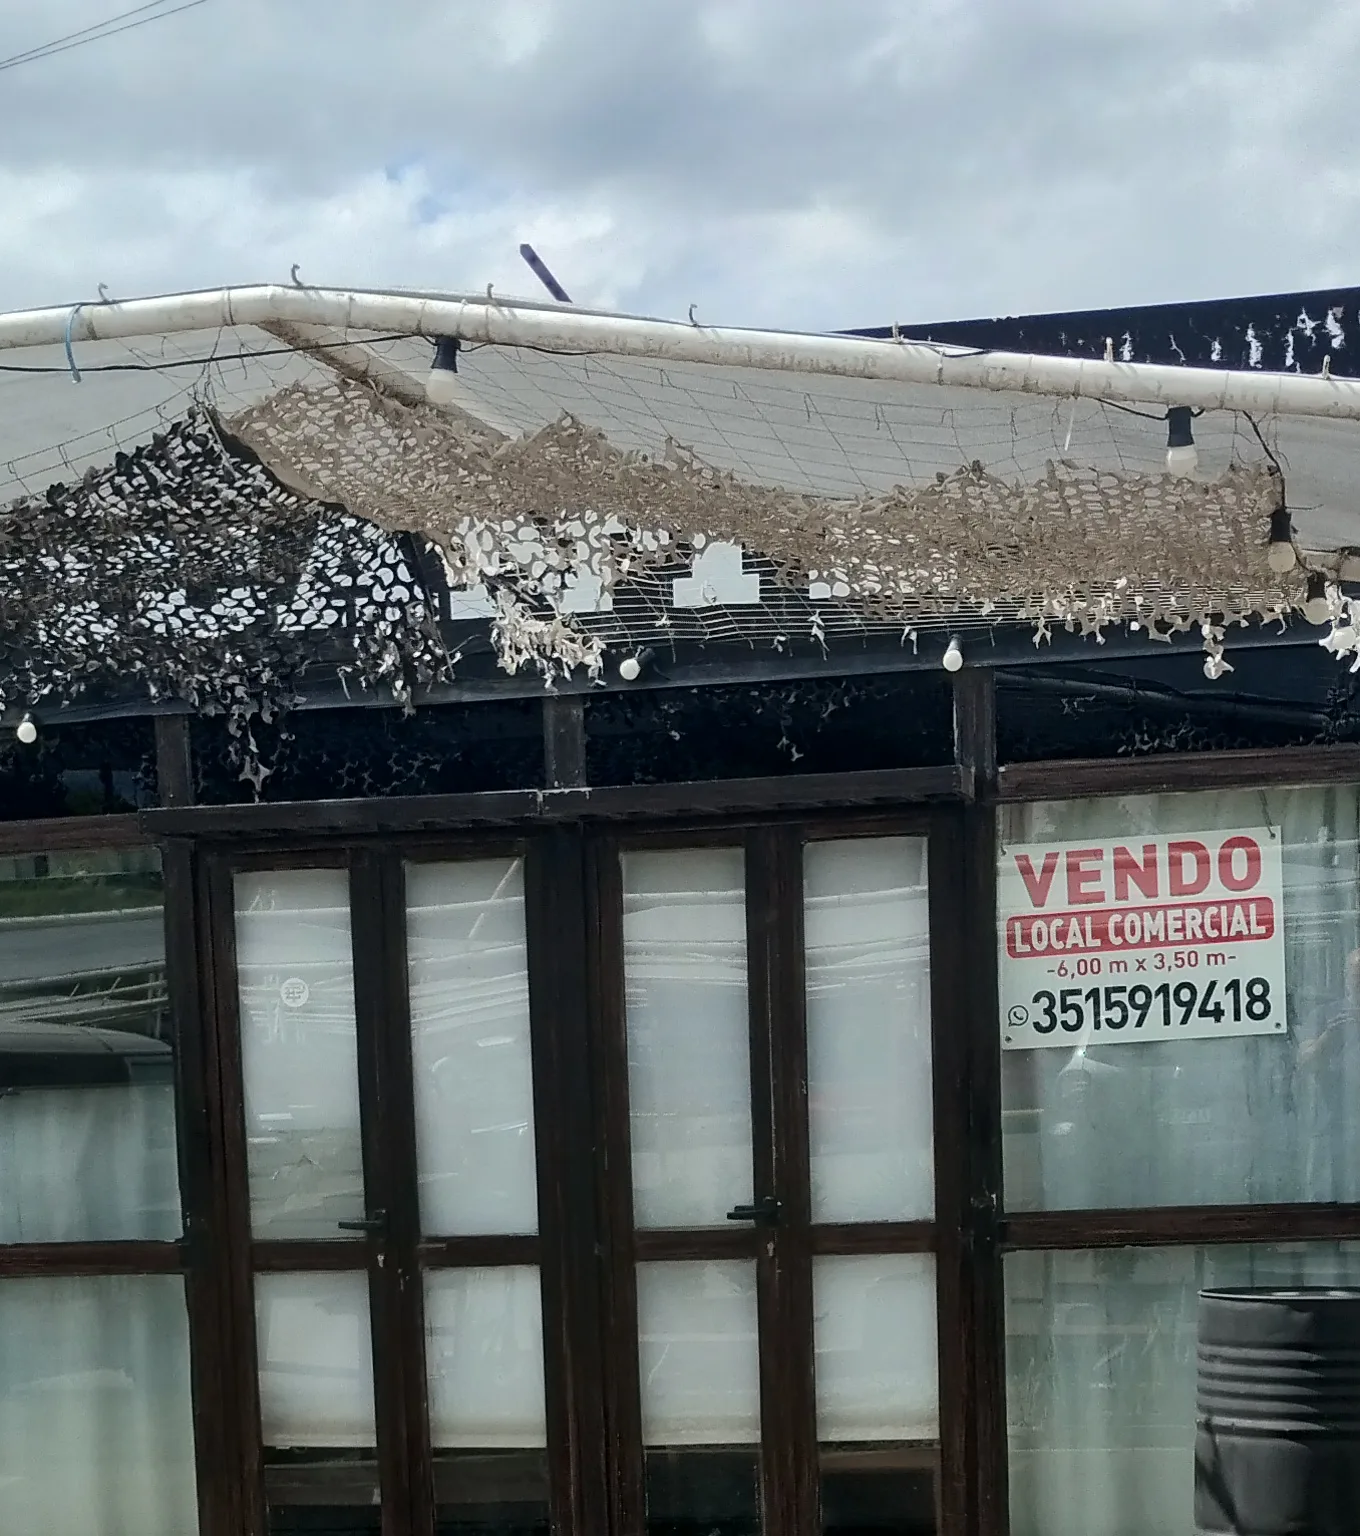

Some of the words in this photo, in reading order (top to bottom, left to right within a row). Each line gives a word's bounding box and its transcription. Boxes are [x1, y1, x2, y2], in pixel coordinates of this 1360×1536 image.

[1013, 835, 1262, 909] VENDO
[1013, 916, 1102, 954] LOCAL
[1108, 902, 1268, 947] COMERCIAL
[1109, 957, 1129, 974] m
[1135, 956, 1148, 973] x
[1153, 950, 1199, 974] 3,50
[1031, 976, 1272, 1035] 3515919418
